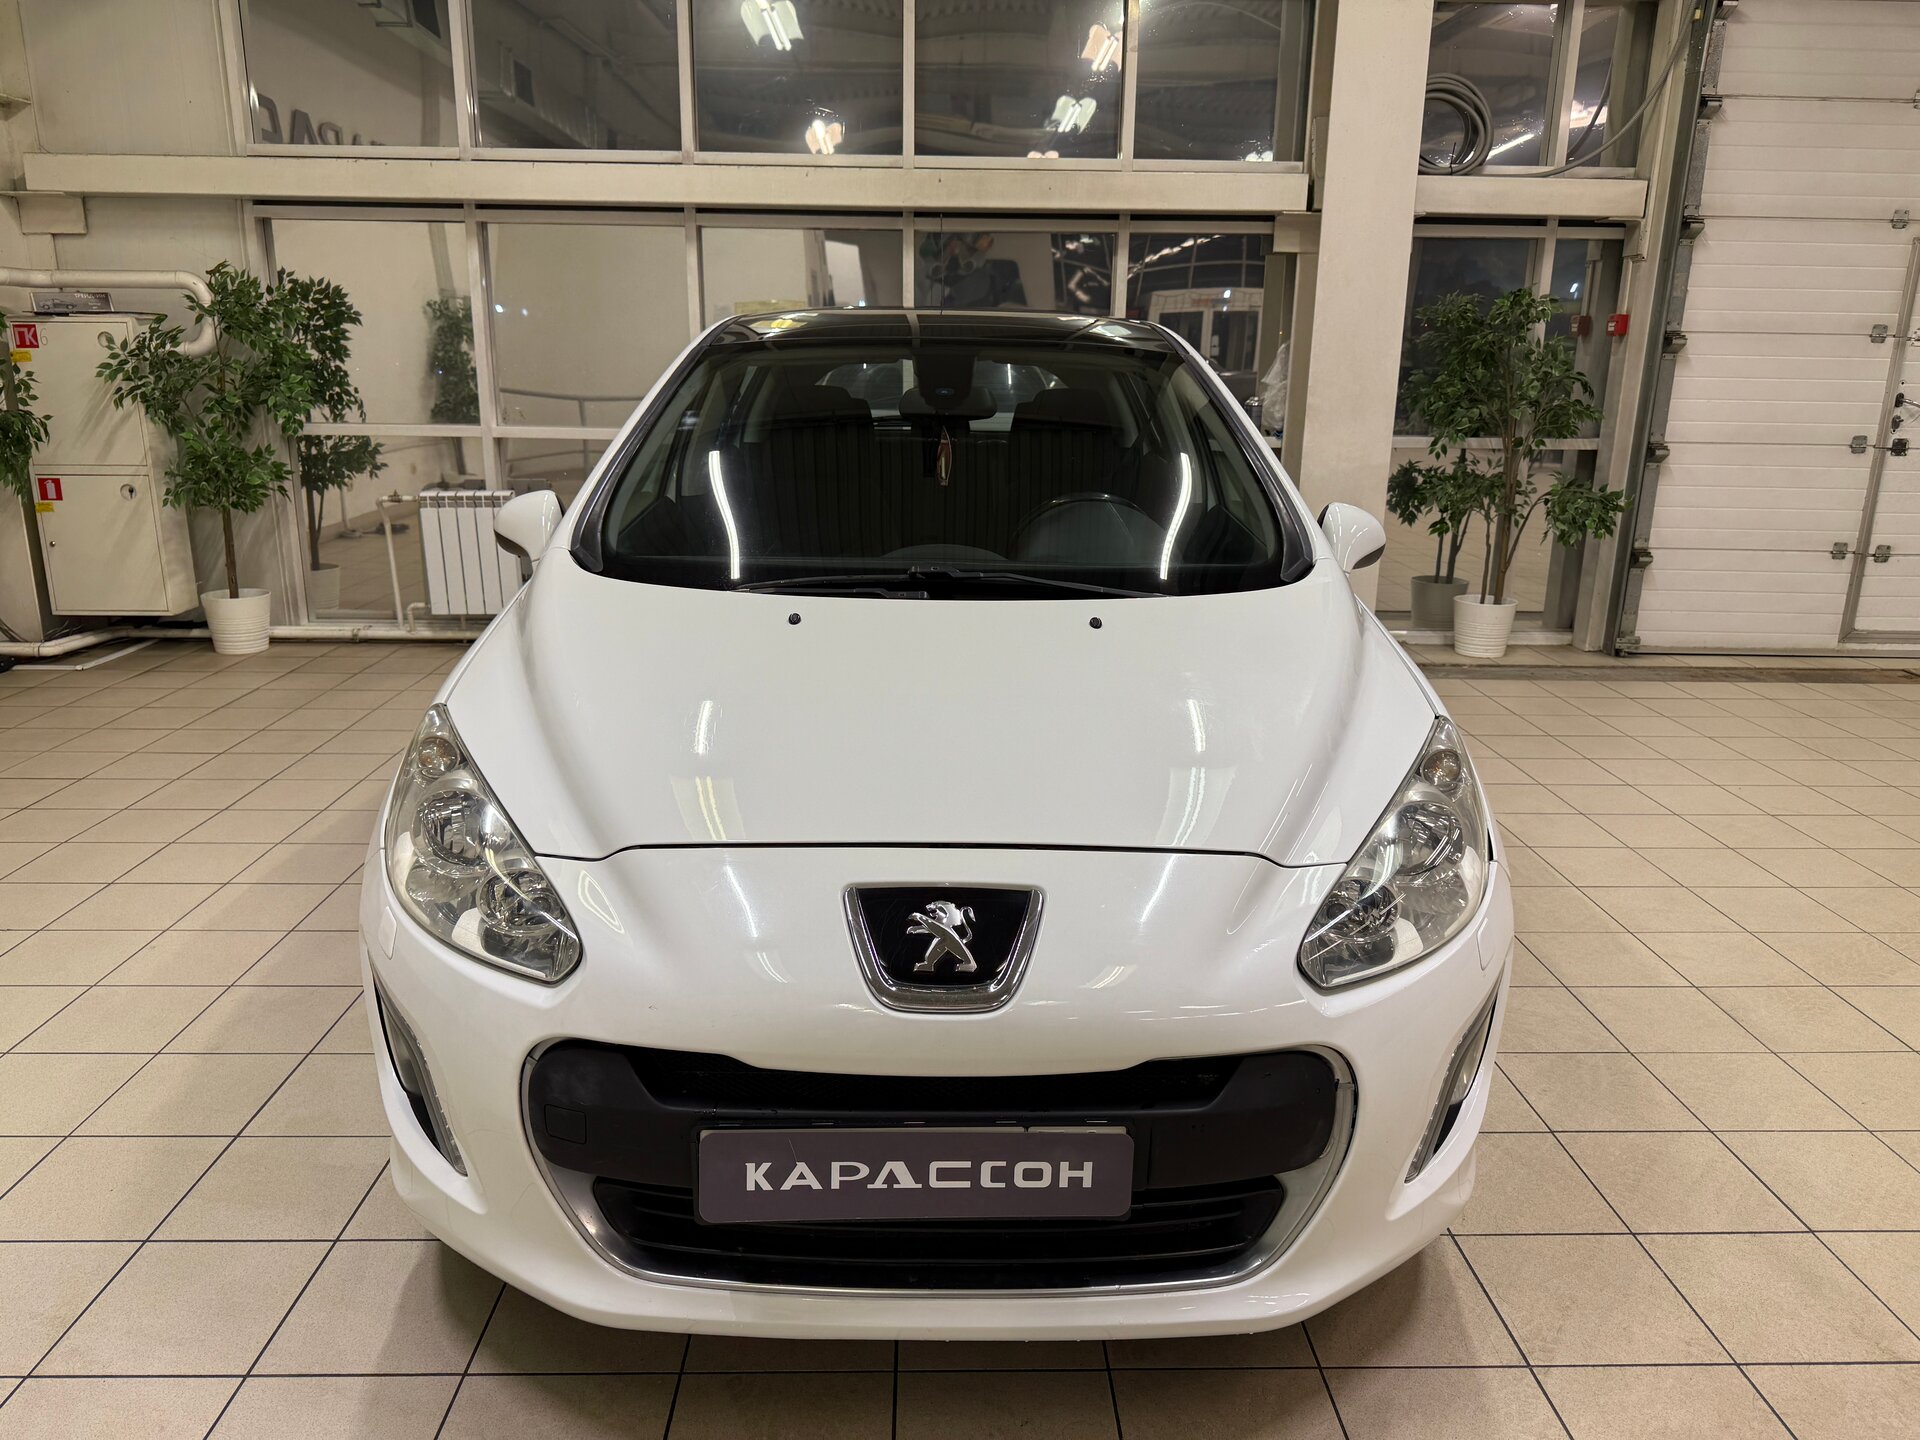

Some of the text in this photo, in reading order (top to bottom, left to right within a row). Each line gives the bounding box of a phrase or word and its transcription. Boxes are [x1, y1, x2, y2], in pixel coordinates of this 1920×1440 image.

[13, 327, 48, 346] ПК 6
[745, 1161, 1093, 1191] КАРАССОН
